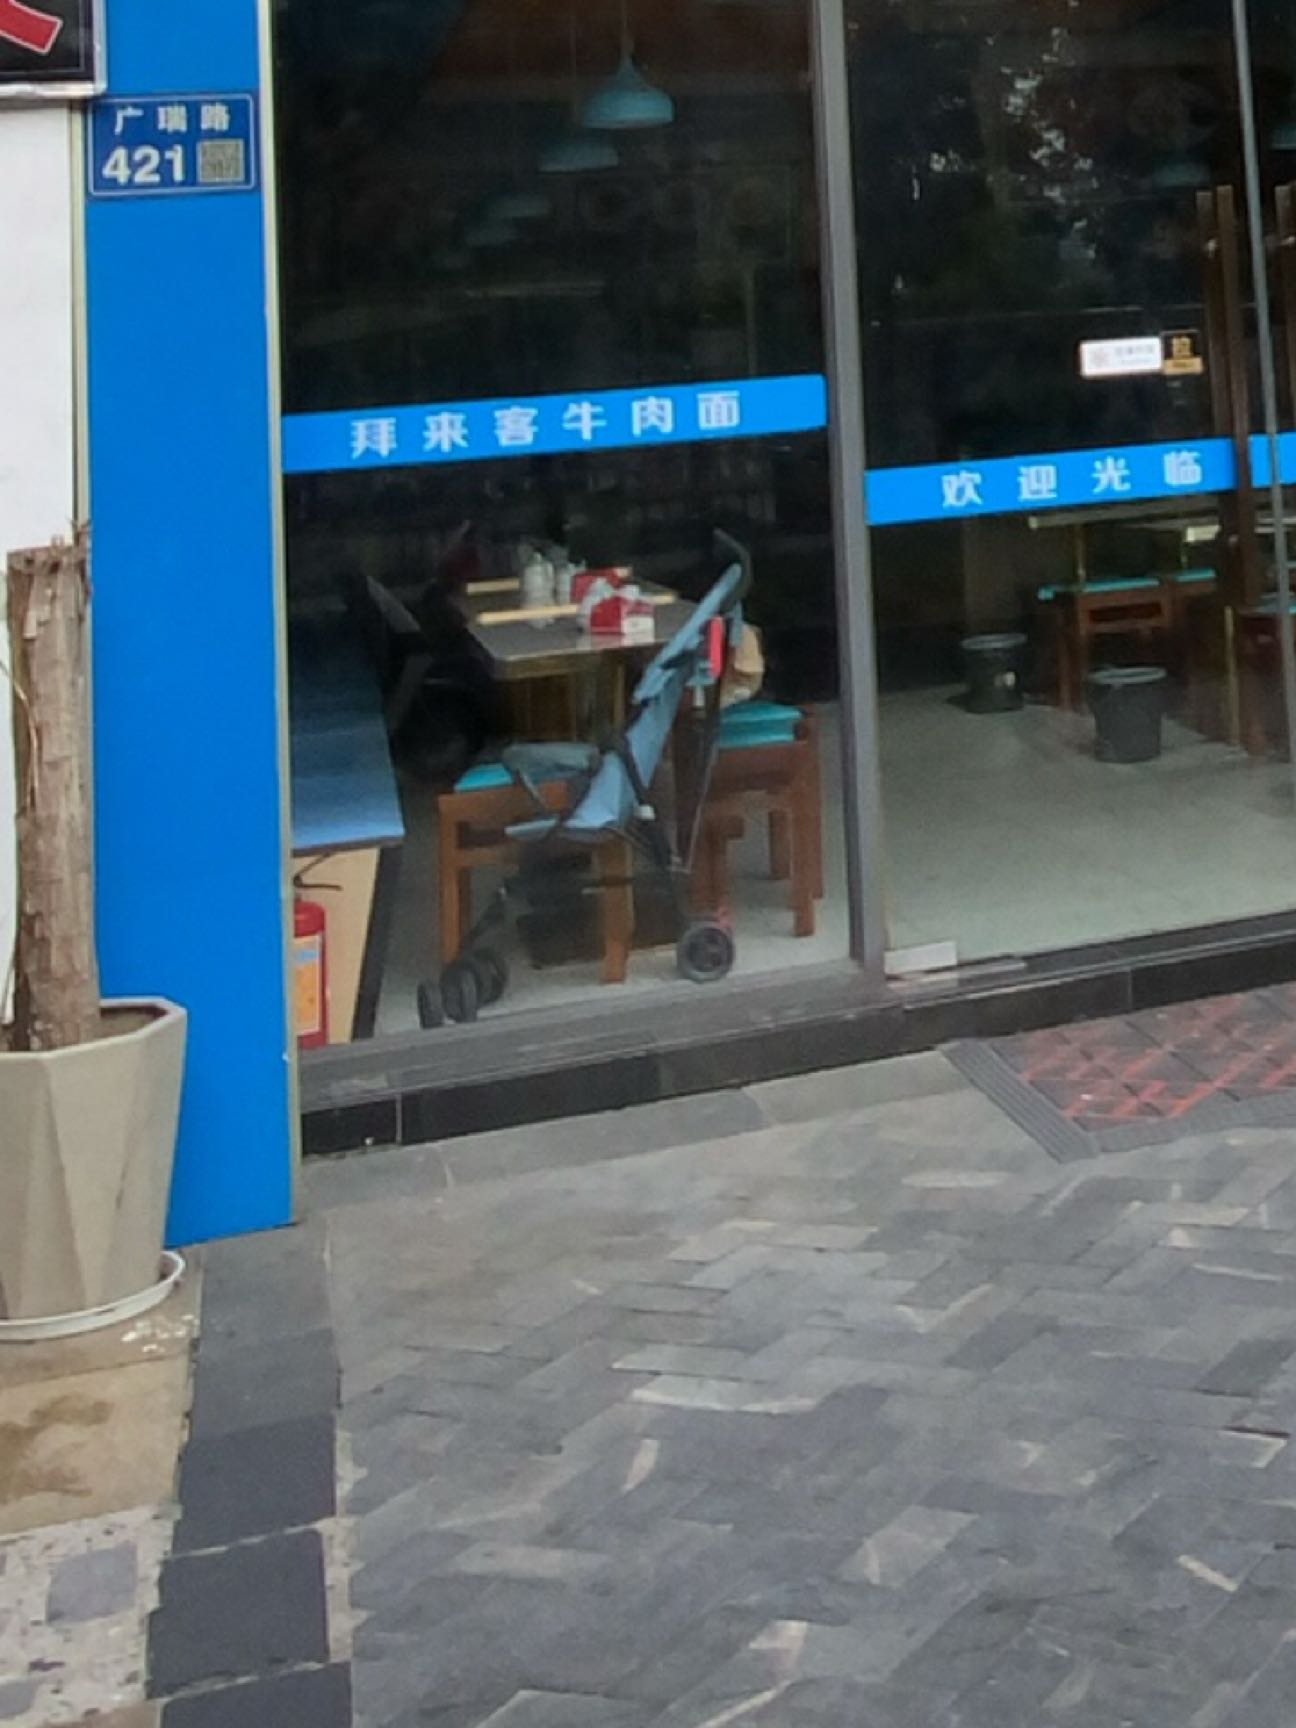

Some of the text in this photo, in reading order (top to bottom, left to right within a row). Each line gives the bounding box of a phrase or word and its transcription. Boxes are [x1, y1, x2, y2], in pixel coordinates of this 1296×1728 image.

[102, 143, 185, 186] 421
[350, 389, 741, 460] 拜来客牛肉面
[941, 449, 1204, 509] 欢迎光临
